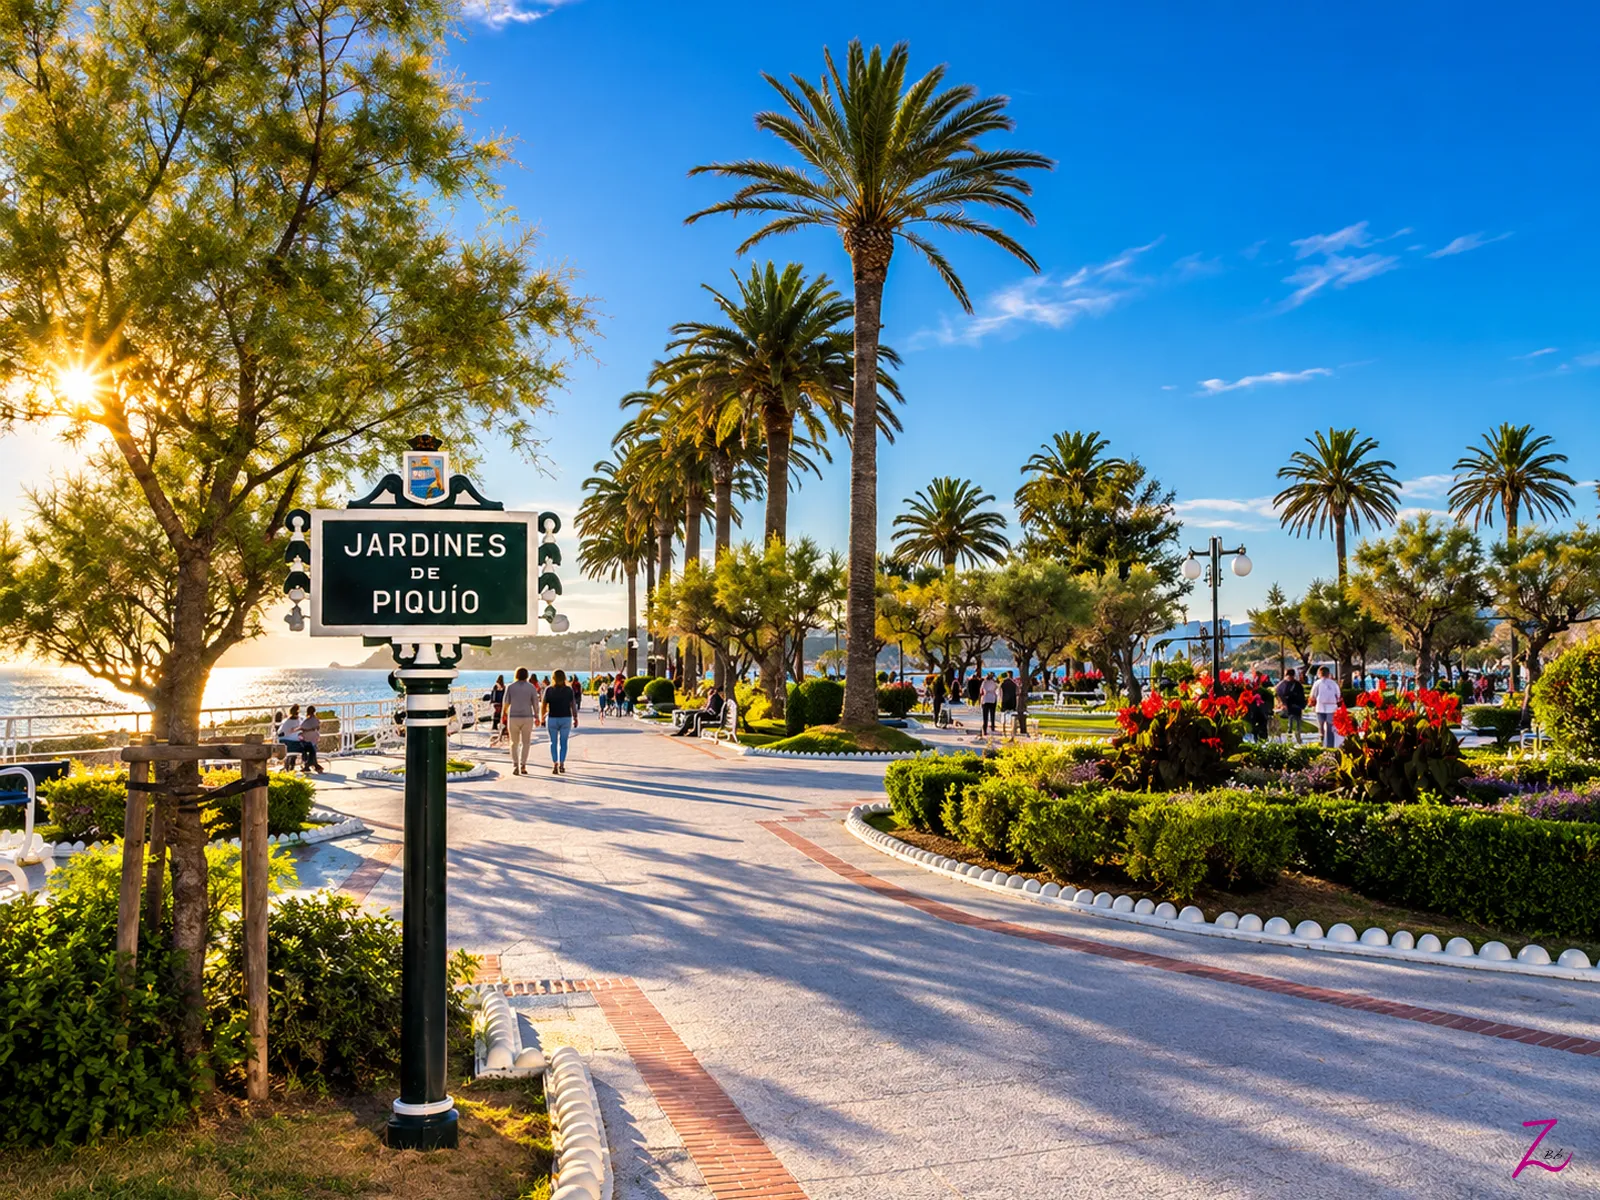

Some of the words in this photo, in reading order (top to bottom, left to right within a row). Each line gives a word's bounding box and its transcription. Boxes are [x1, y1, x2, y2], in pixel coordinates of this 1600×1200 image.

[344, 532, 507, 557] JARDINES
[410, 567, 440, 580] DE
[373, 584, 479, 614] PIQUÍO
